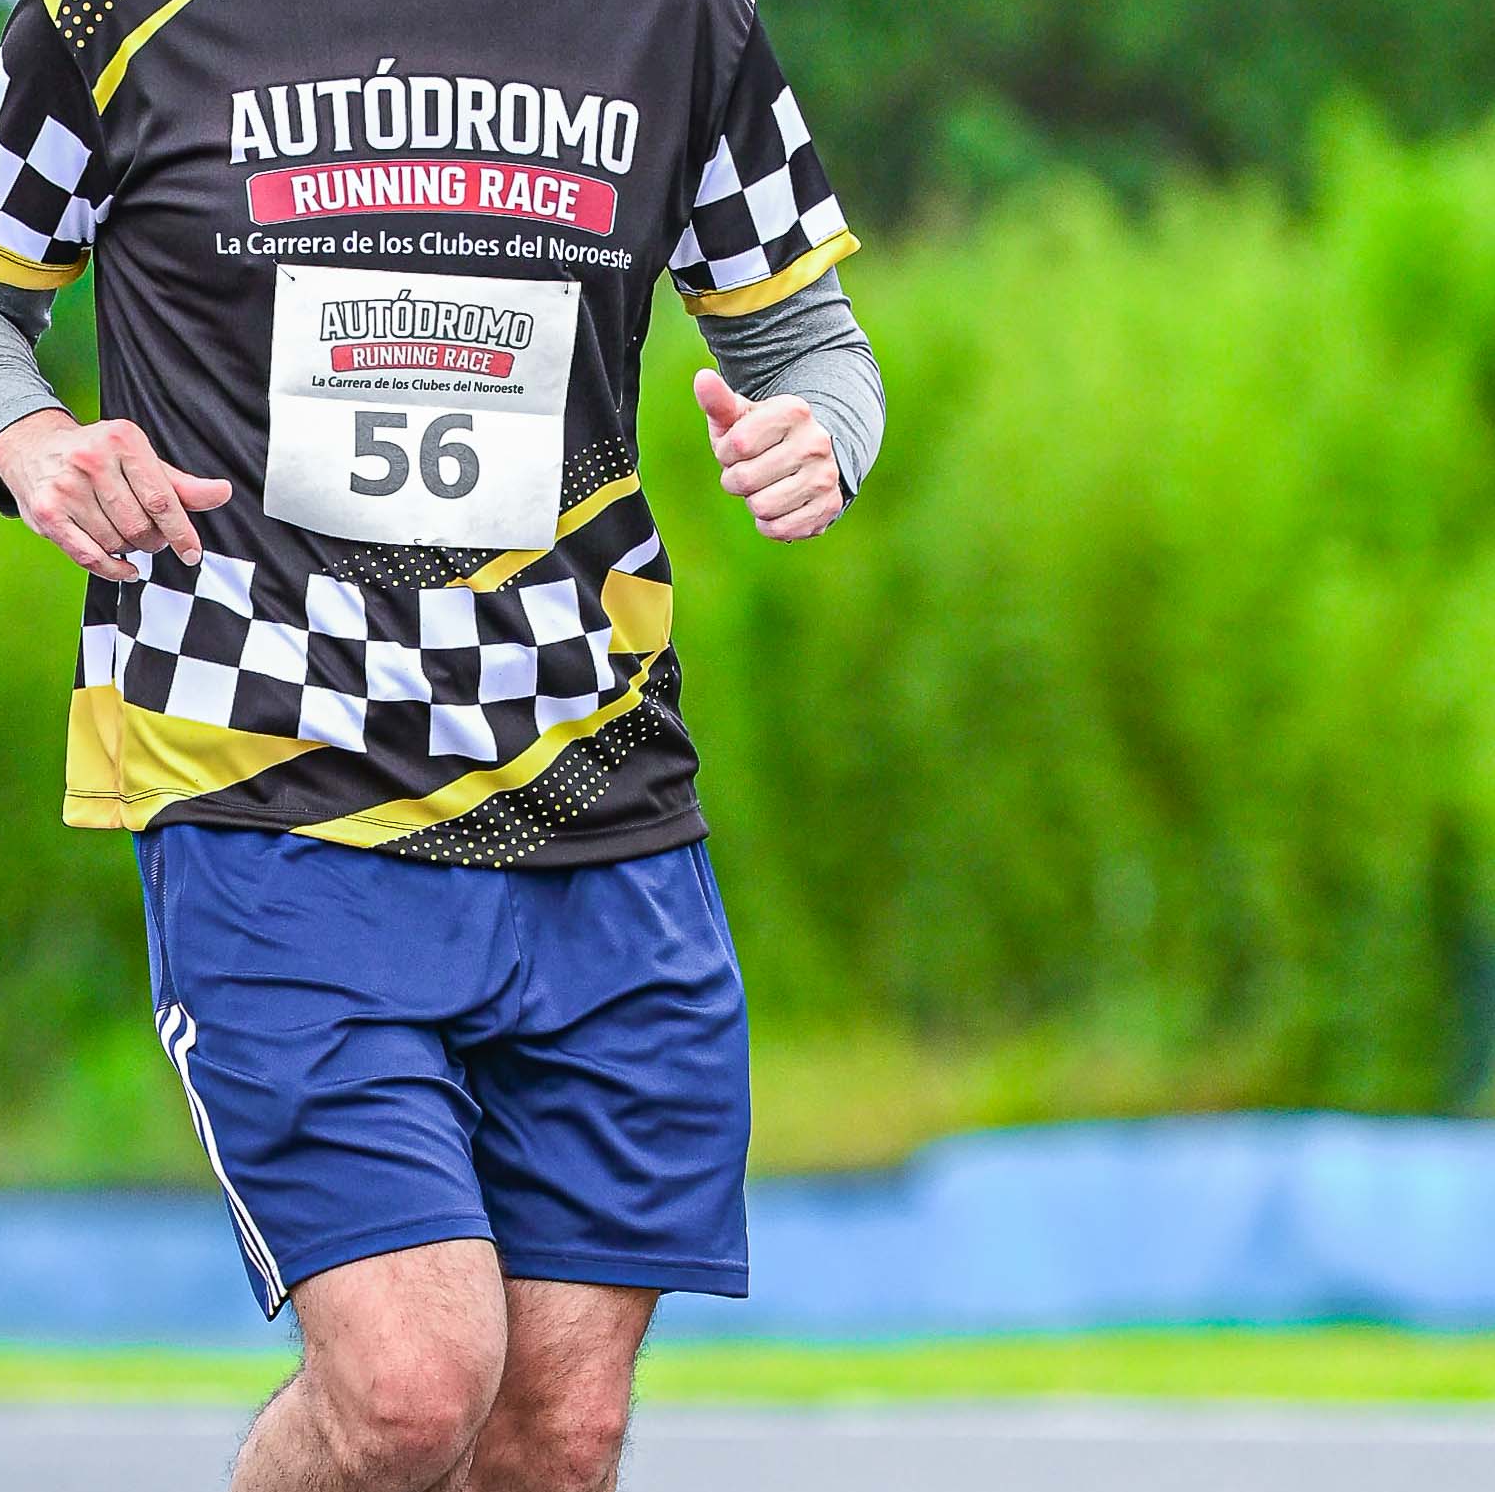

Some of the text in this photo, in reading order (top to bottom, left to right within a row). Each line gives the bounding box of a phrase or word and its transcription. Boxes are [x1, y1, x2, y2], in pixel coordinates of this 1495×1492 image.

[229, 58, 640, 176] AUTÓDROMO
[290, 165, 581, 222] RUNNING RACE
[215, 230, 632, 271] La Carrera de los Clubes del Noroeste
[319, 288, 534, 350] AUTÓDROMO
[311, 375, 525, 395] La Carrera de los Clubes del Noroeste
[351, 345, 494, 374] RUNNING RACE
[349, 410, 481, 499] 56
